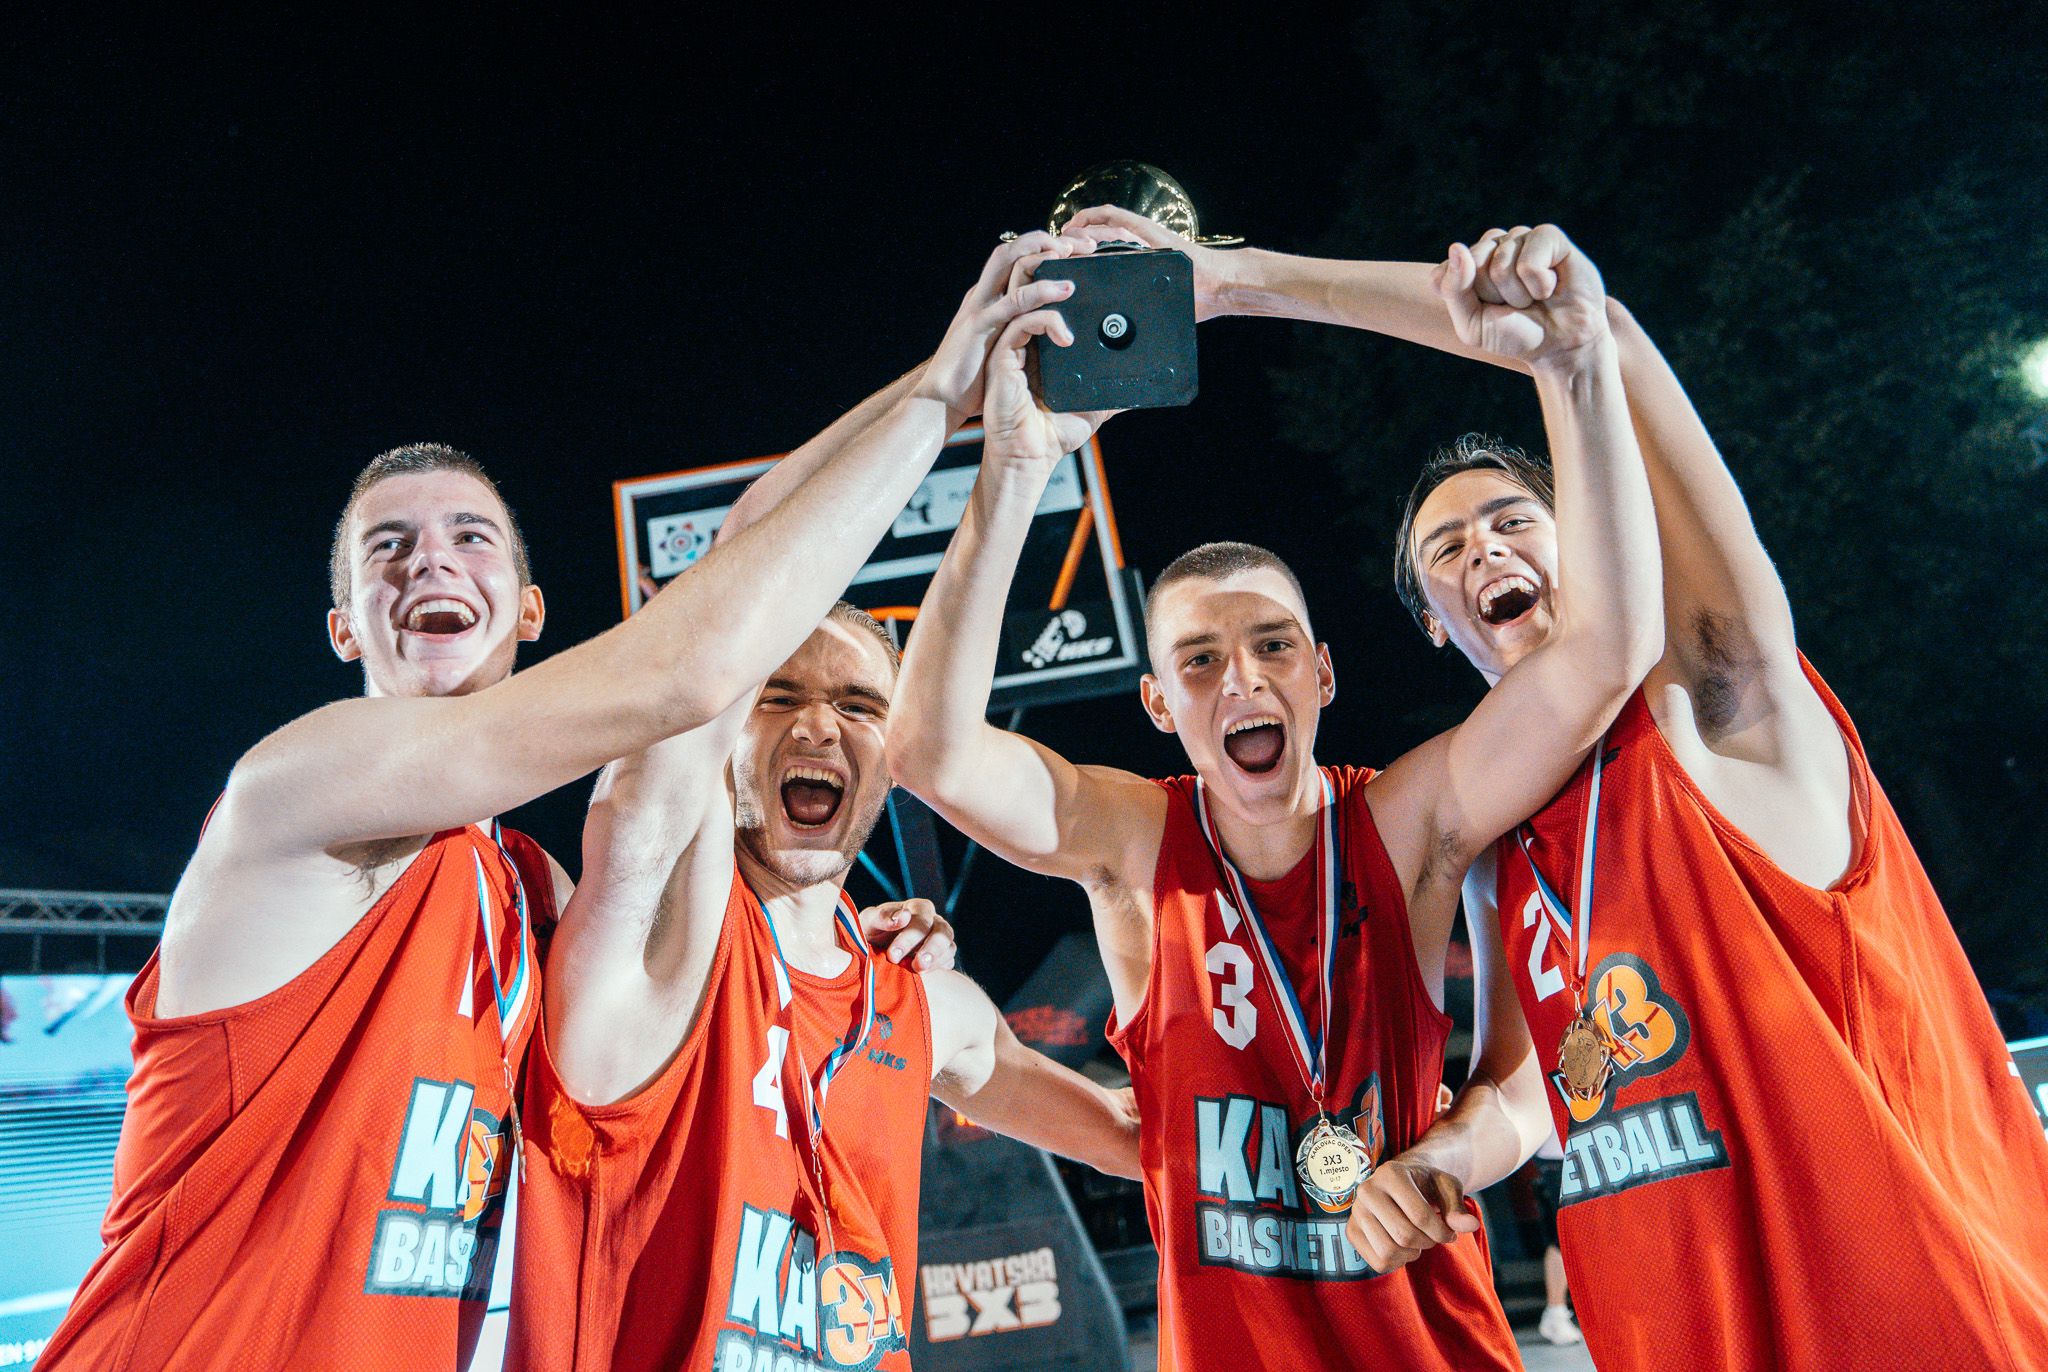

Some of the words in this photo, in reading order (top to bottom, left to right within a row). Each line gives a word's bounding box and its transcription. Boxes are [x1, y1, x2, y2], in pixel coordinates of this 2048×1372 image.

[1205, 941, 1257, 1051] 3
[1523, 890, 1566, 1002] 2
[752, 1025, 790, 1140] 4
[1197, 1098, 1298, 1209] KA
[1310, 1140, 1336, 1160] KARLOVAC
[1337, 1141, 1352, 1154] OPEN
[1322, 1154, 1342, 1166] 3X3
[731, 1208, 817, 1351] KA
[924, 1280, 1062, 1343] 3X3
